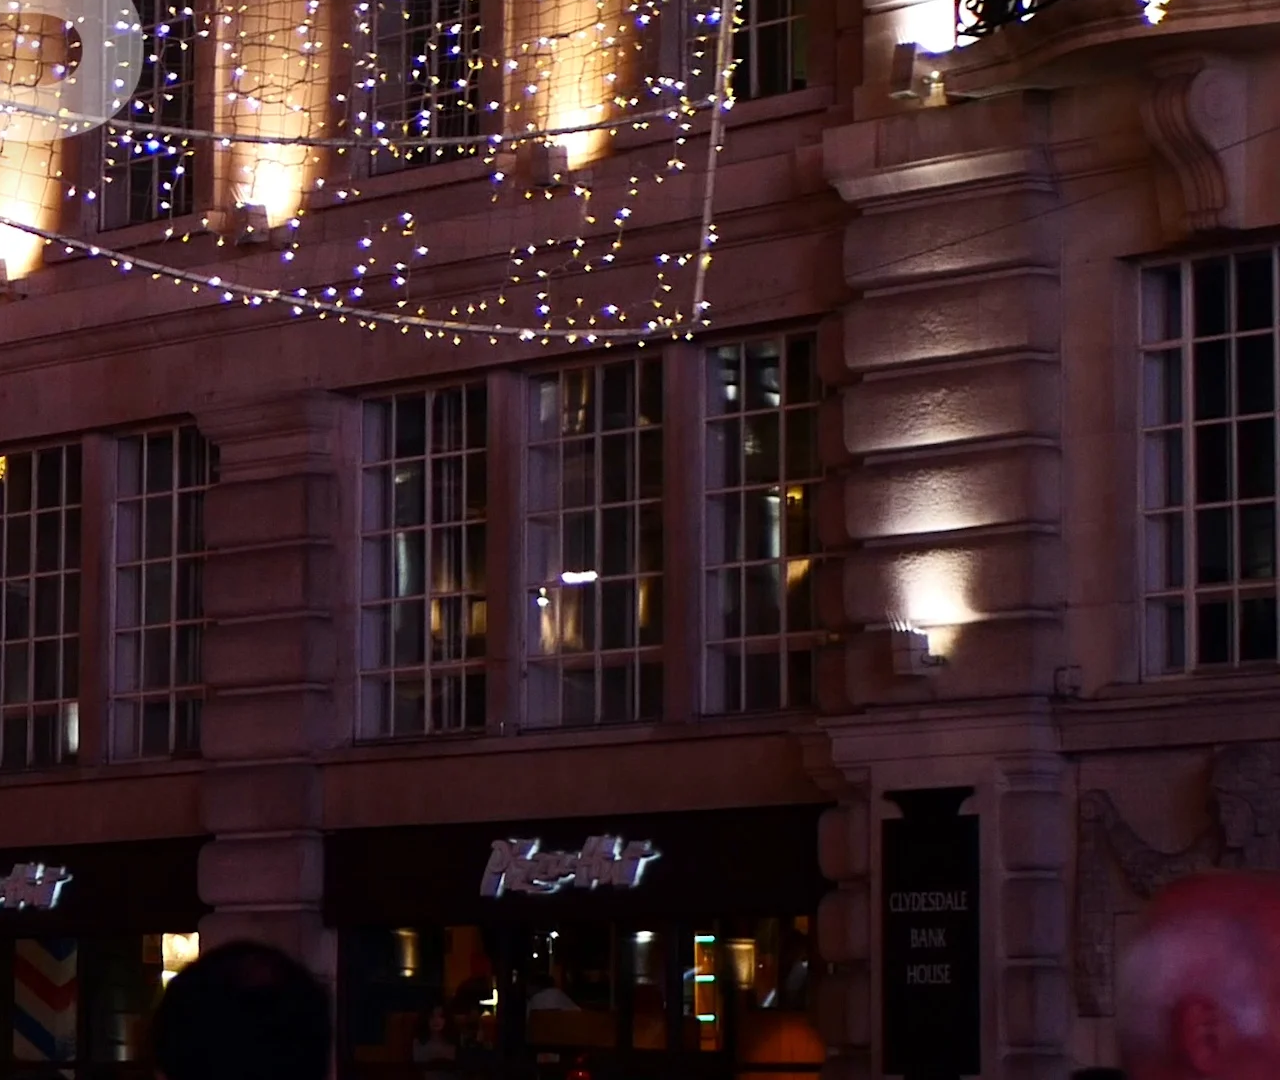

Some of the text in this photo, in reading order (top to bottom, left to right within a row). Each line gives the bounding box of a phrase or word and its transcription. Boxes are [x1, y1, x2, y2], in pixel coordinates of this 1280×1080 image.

[889, 890, 969, 912] CLYDESDALE
[910, 926, 947, 948] BANK
[906, 963, 952, 984] HOUSE
